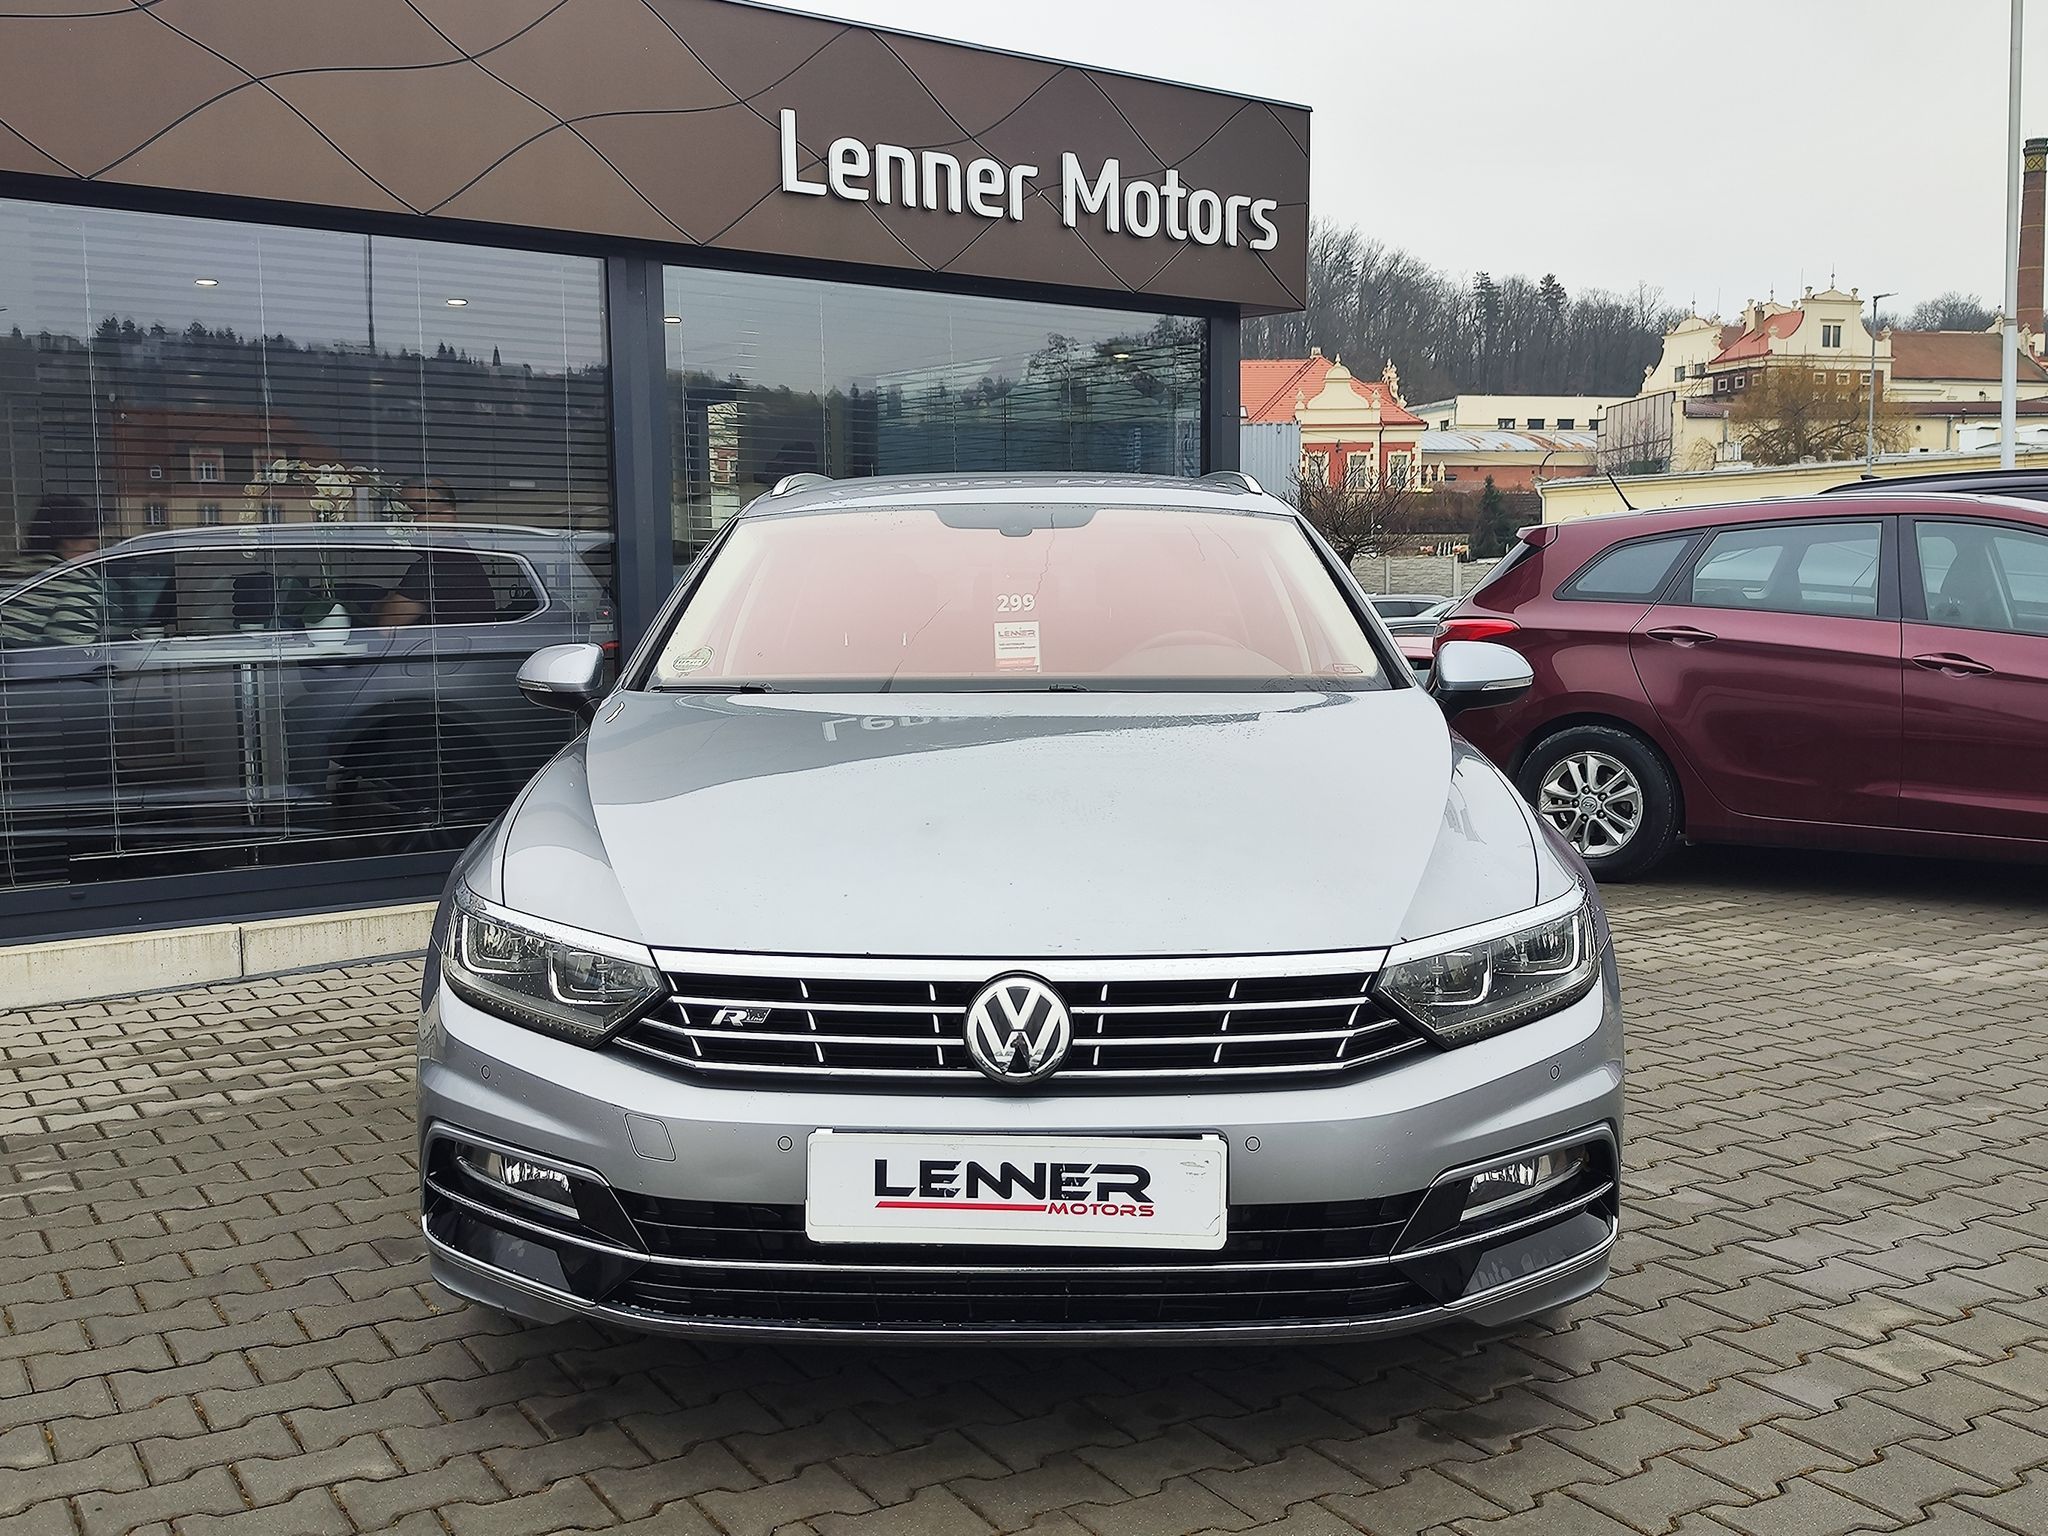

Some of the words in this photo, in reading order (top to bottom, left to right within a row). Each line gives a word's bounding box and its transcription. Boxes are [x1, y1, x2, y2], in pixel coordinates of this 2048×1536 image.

[780, 108, 1039, 222] Lenner
[1061, 151, 1279, 252] Motors
[997, 593, 1036, 612] 299
[874, 1158, 1155, 1204] LENNER
[1047, 1203, 1155, 1217] MOTORS
